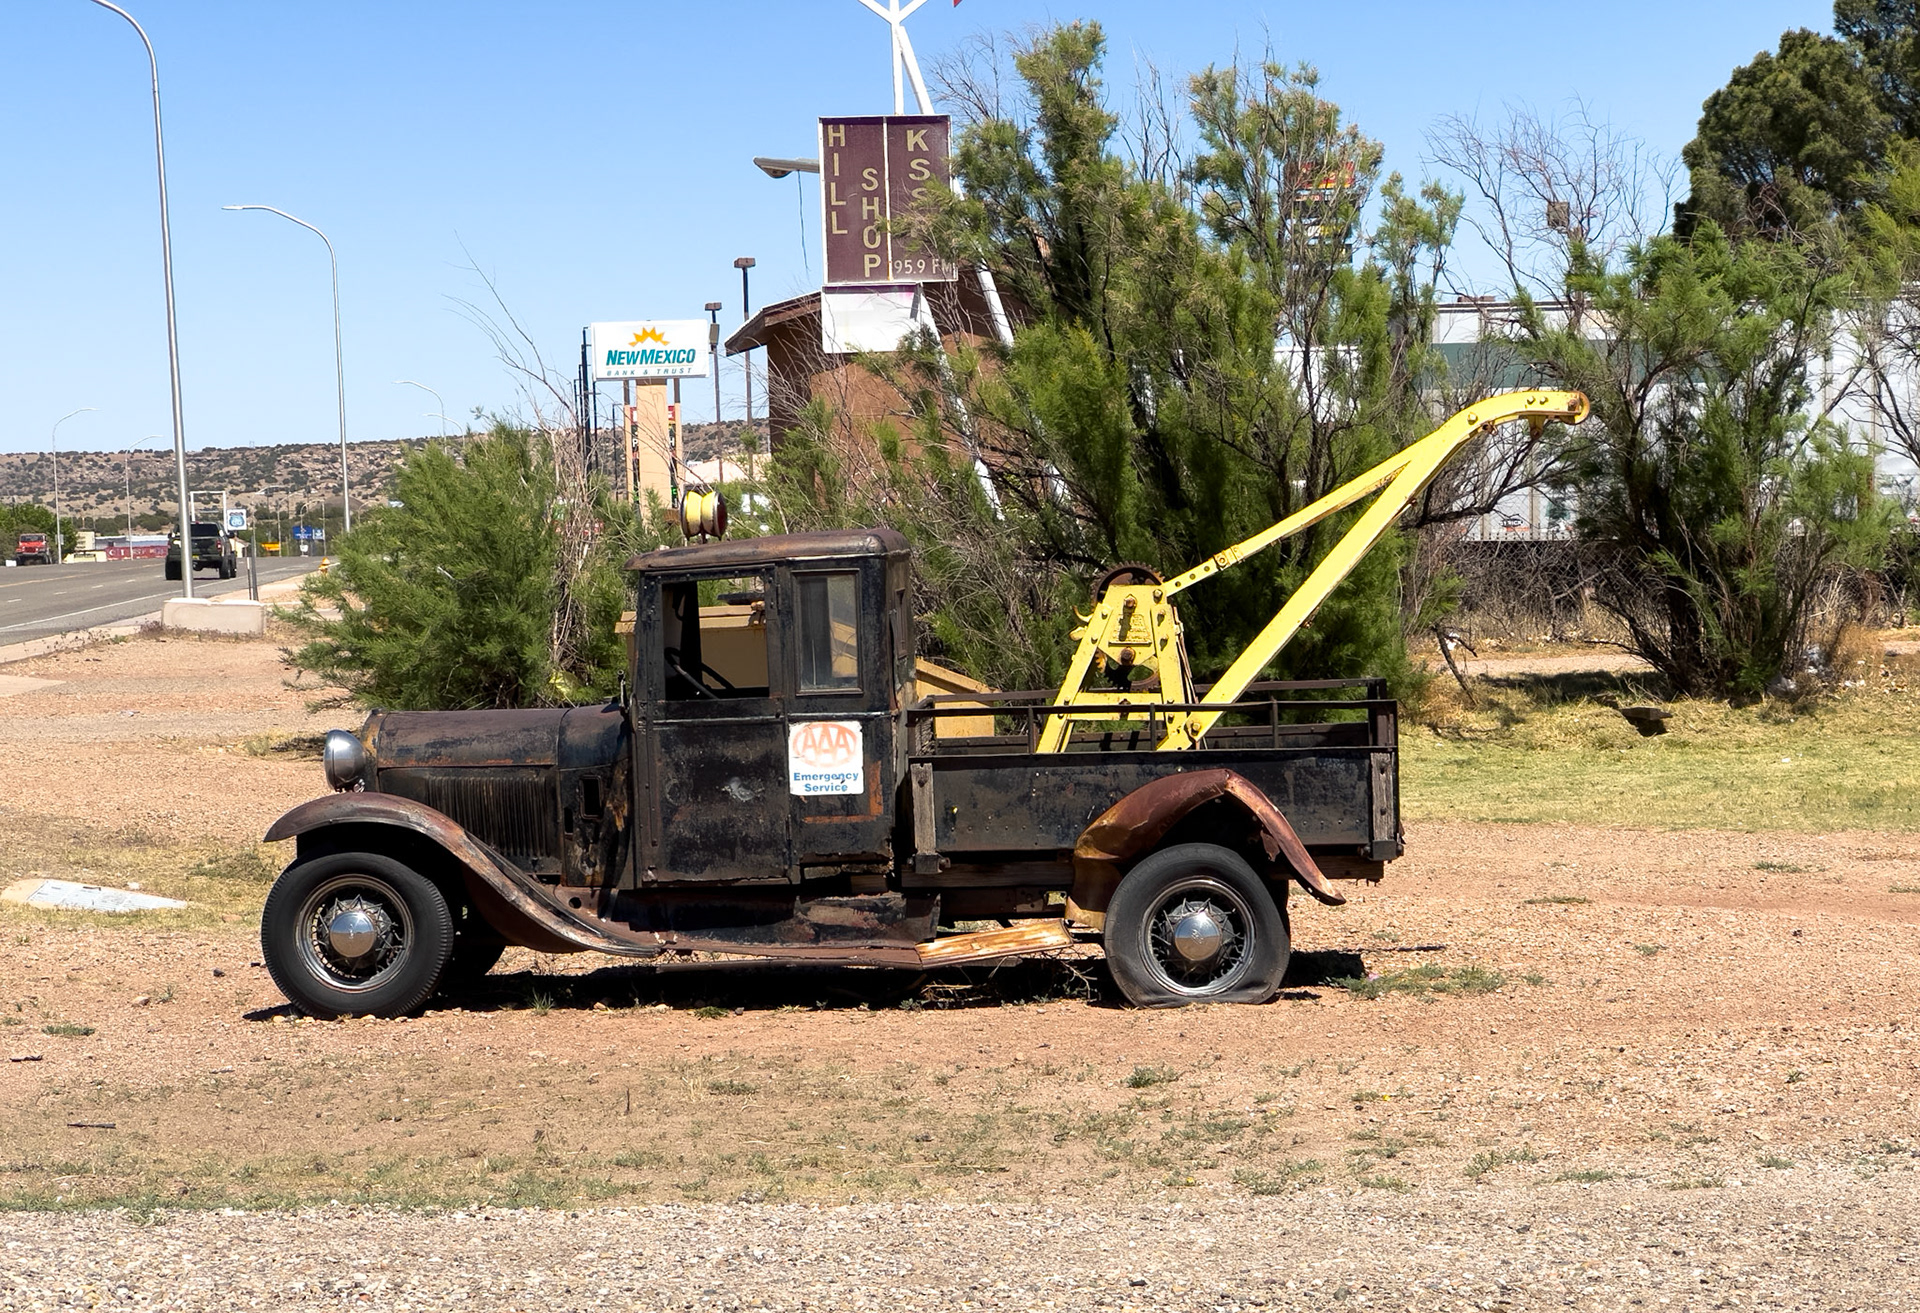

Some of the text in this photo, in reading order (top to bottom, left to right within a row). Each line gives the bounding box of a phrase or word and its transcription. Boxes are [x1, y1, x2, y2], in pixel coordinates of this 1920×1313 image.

[827, 124, 848, 235] HILL
[861, 167, 882, 278] SHOP
[894, 259, 926, 274] 95.9
[606, 369, 636, 377] BANK
[656, 367, 693, 375] TRUST
[800, 723, 854, 762] AAA
[793, 772, 859, 782] Emergency
[804, 782, 848, 792] Service
